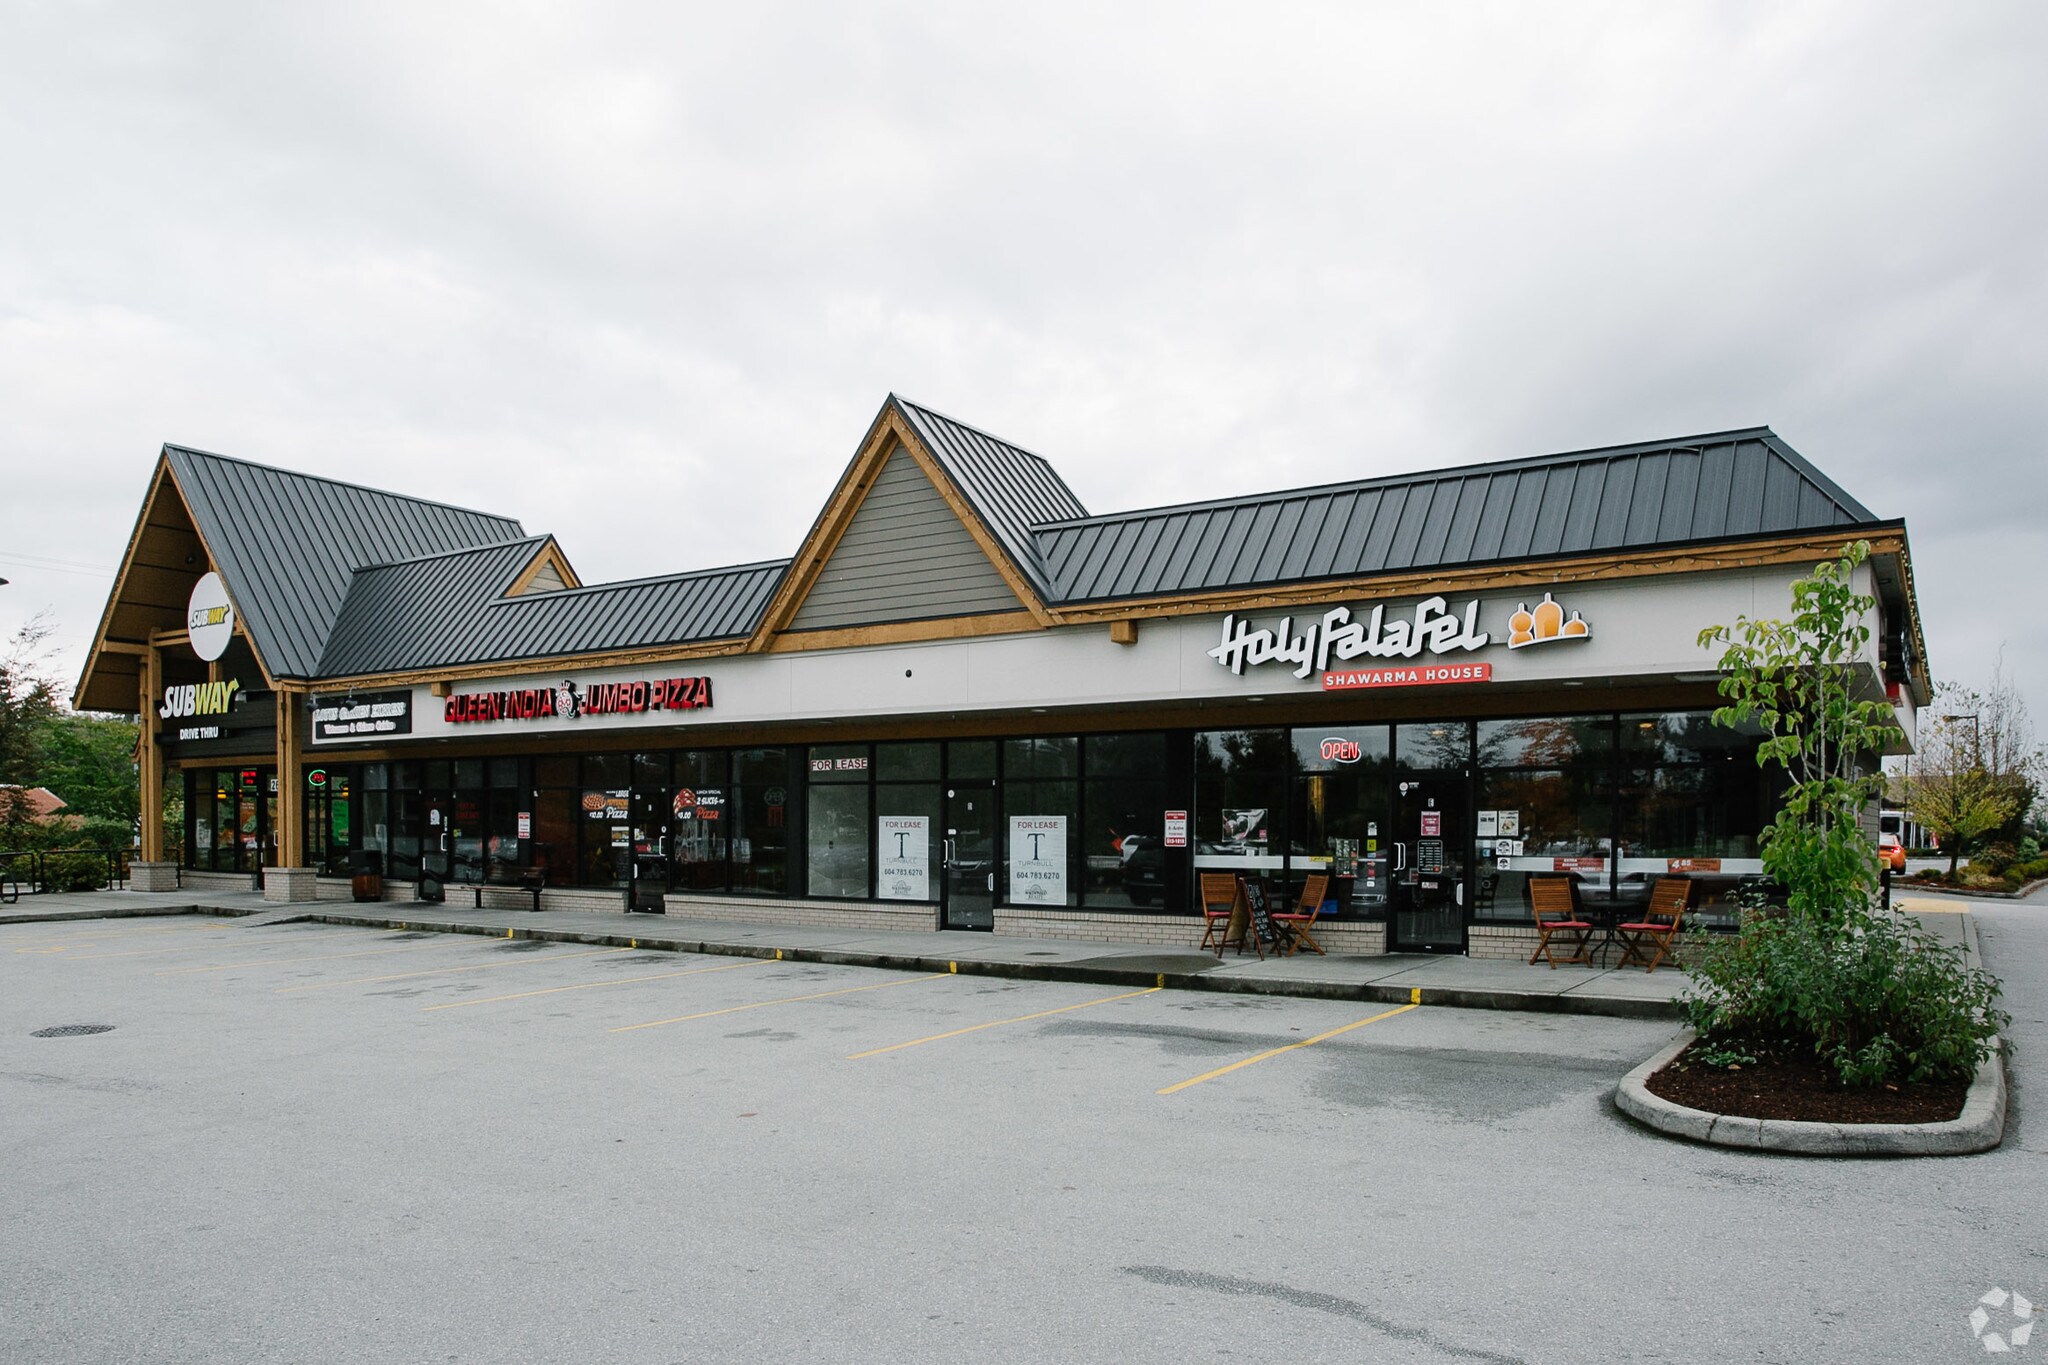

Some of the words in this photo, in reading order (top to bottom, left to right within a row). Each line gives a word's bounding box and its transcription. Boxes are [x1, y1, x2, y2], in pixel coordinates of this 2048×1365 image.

[190, 604, 230, 629] SUBWAY
[1326, 671, 1418, 686] SHAWARMA
[1426, 667, 1483, 680] HOUSE
[159, 678, 239, 719] SUBWAY
[444, 691, 504, 722] QUEEN
[506, 687, 556, 719] INDIA
[578, 681, 650, 714] JUMBO
[651, 677, 713, 710] PIZZA
[180, 728, 199, 740] DRIVE
[200, 726, 218, 738] THRU
[1321, 742, 1359, 759] OPEN
[811, 760, 831, 771] FOR
[835, 758, 867, 769] LEASE
[606, 806, 628, 819] Pizza
[695, 806, 719, 820] Pizza
[894, 832, 910, 859] T
[1027, 833, 1045, 860] T
[884, 869, 922, 877] 604.783.6270
[1016, 872, 1059, 880] 604.783.6270
